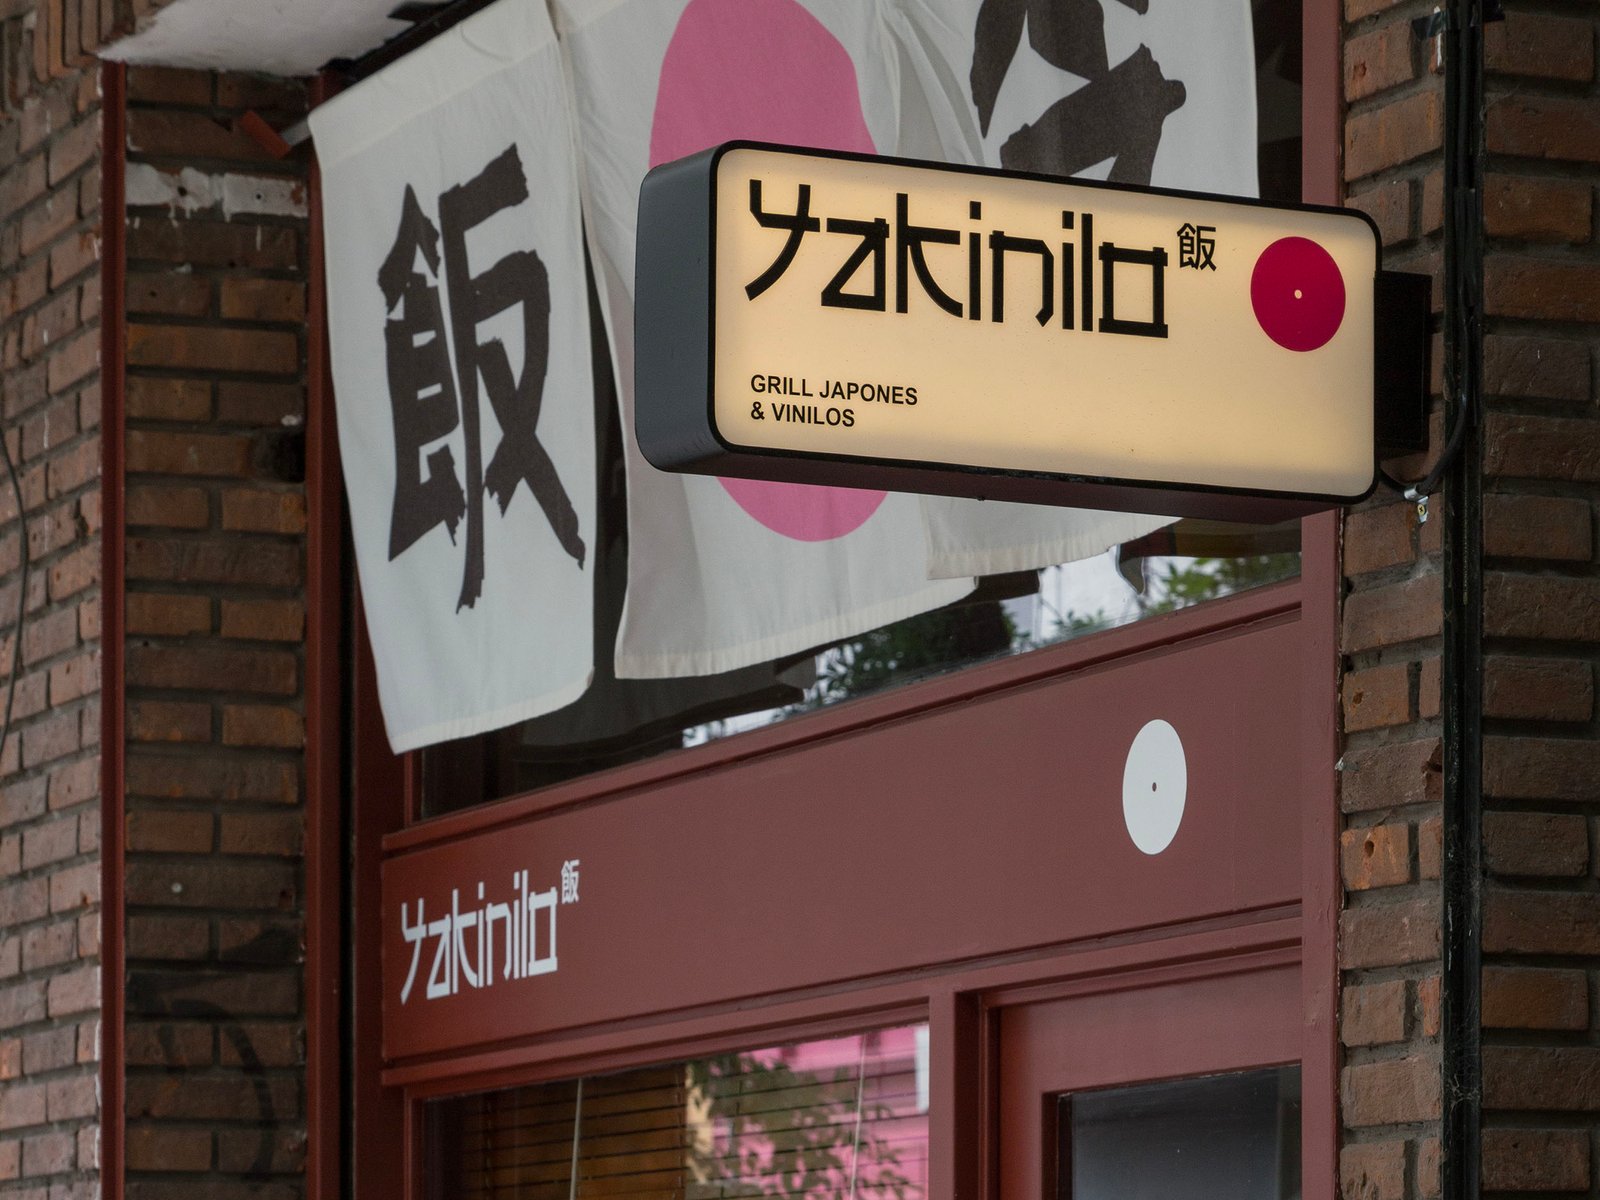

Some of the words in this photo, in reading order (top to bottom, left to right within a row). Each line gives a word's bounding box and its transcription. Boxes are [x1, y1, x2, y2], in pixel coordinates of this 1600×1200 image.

[1176, 222, 1217, 272] 飯
[377, 142, 585, 614] 飯
[750, 374, 814, 397] GRILL
[819, 380, 918, 406] JAPONES
[750, 401, 766, 421] &
[771, 402, 856, 428] VINILOS
